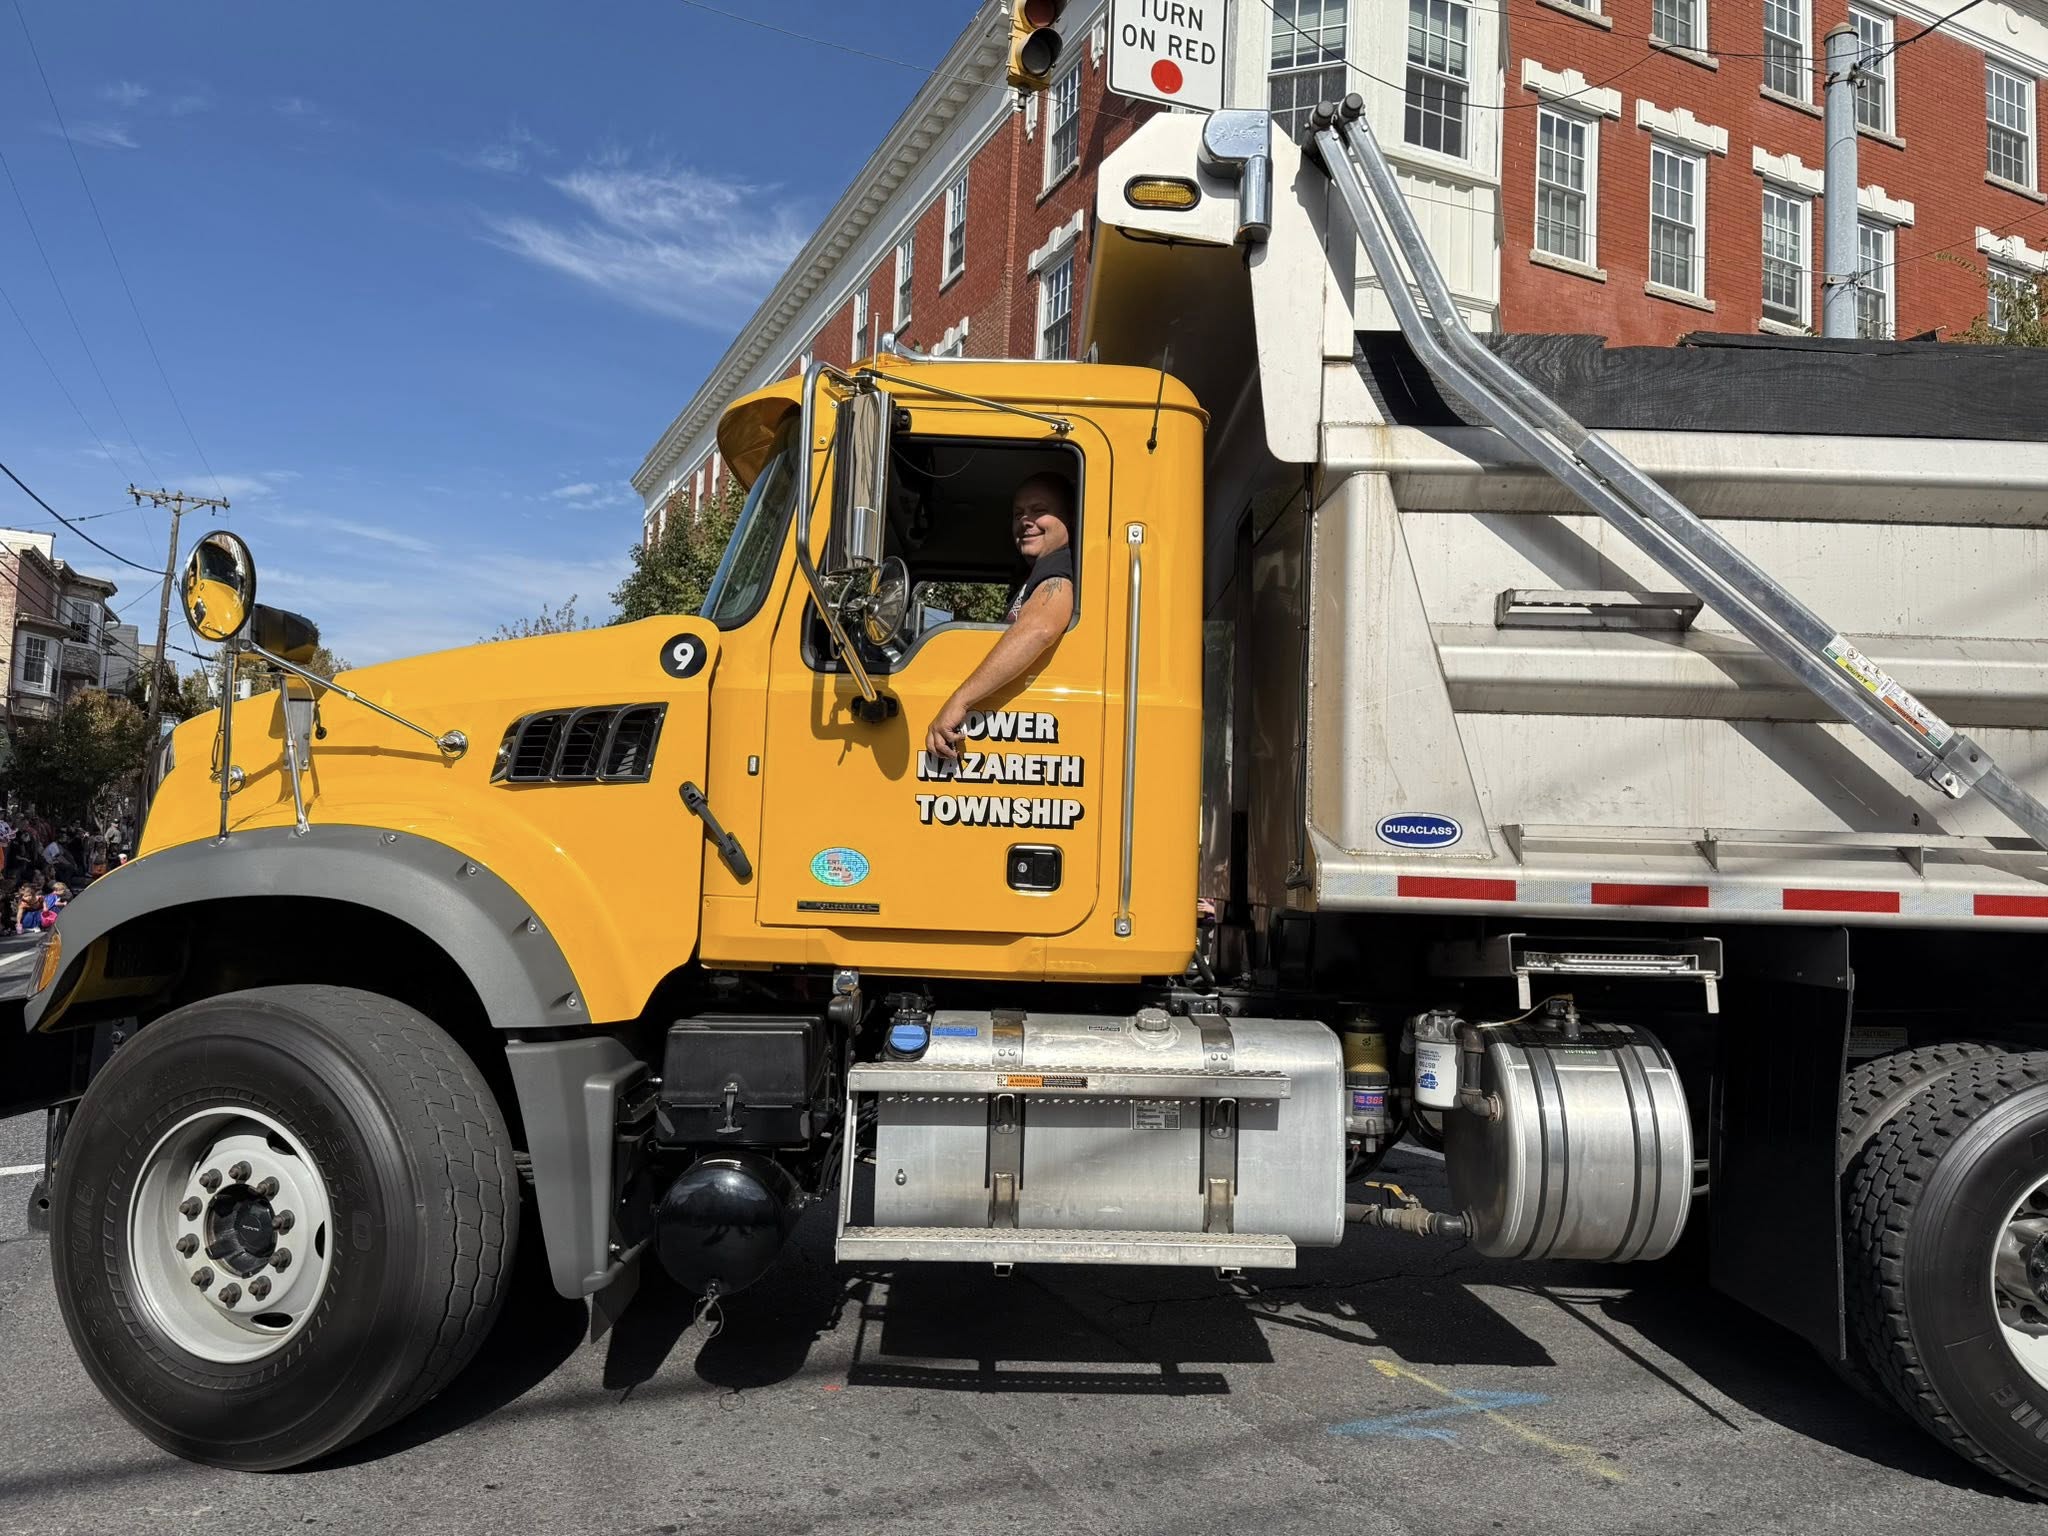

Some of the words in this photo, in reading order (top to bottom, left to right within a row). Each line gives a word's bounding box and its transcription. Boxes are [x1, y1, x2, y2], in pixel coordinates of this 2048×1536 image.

[1122, 24, 1155, 52] ON
[1168, 34, 1216, 65] RED
[673, 642, 695, 670] 9
[957, 709, 1059, 744] OWER
[916, 750, 1085, 787] NAZARETH
[915, 794, 1085, 830] TOWNSHIP
[1385, 824, 1452, 836] DURACLASS
